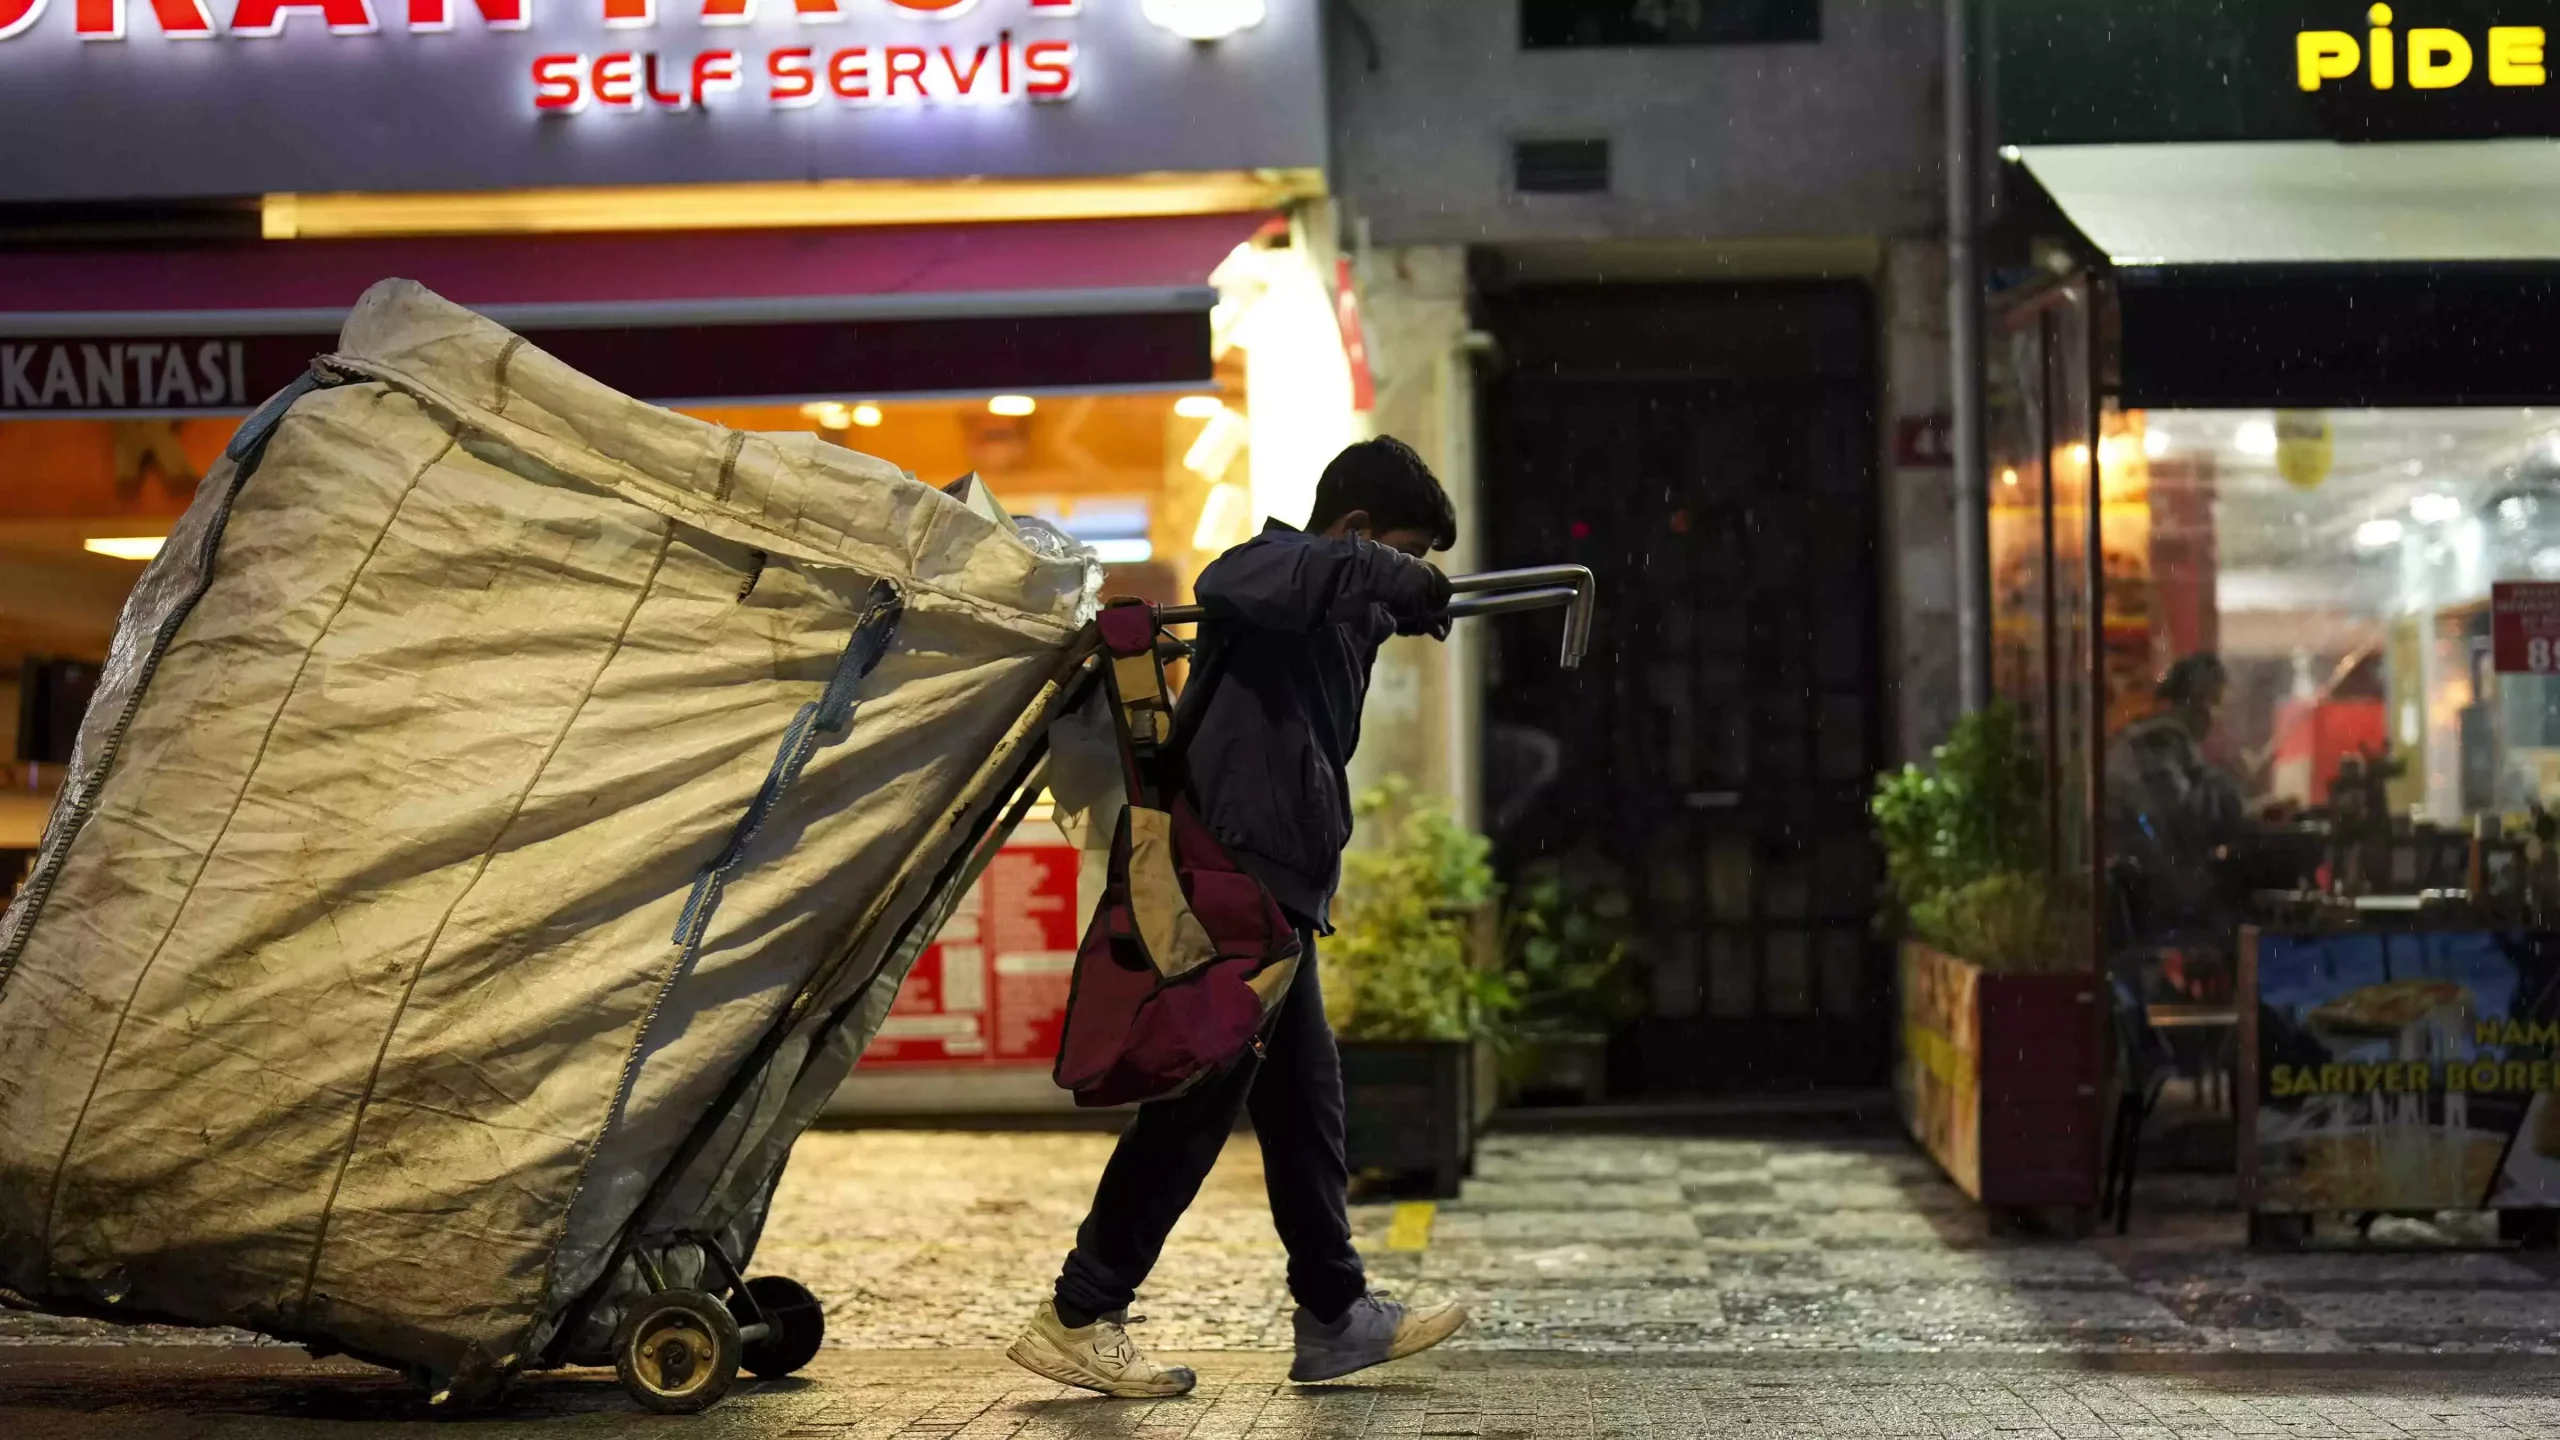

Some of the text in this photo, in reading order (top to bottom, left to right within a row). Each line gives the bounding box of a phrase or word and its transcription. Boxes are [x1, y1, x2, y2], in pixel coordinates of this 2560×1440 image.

[531, 30, 1076, 112] SELF SERVİS
[2296, 2, 2546, 91] PİDE
[2, 341, 247, 407] KANTASI
[2270, 1061, 2430, 1096] SARIYER
